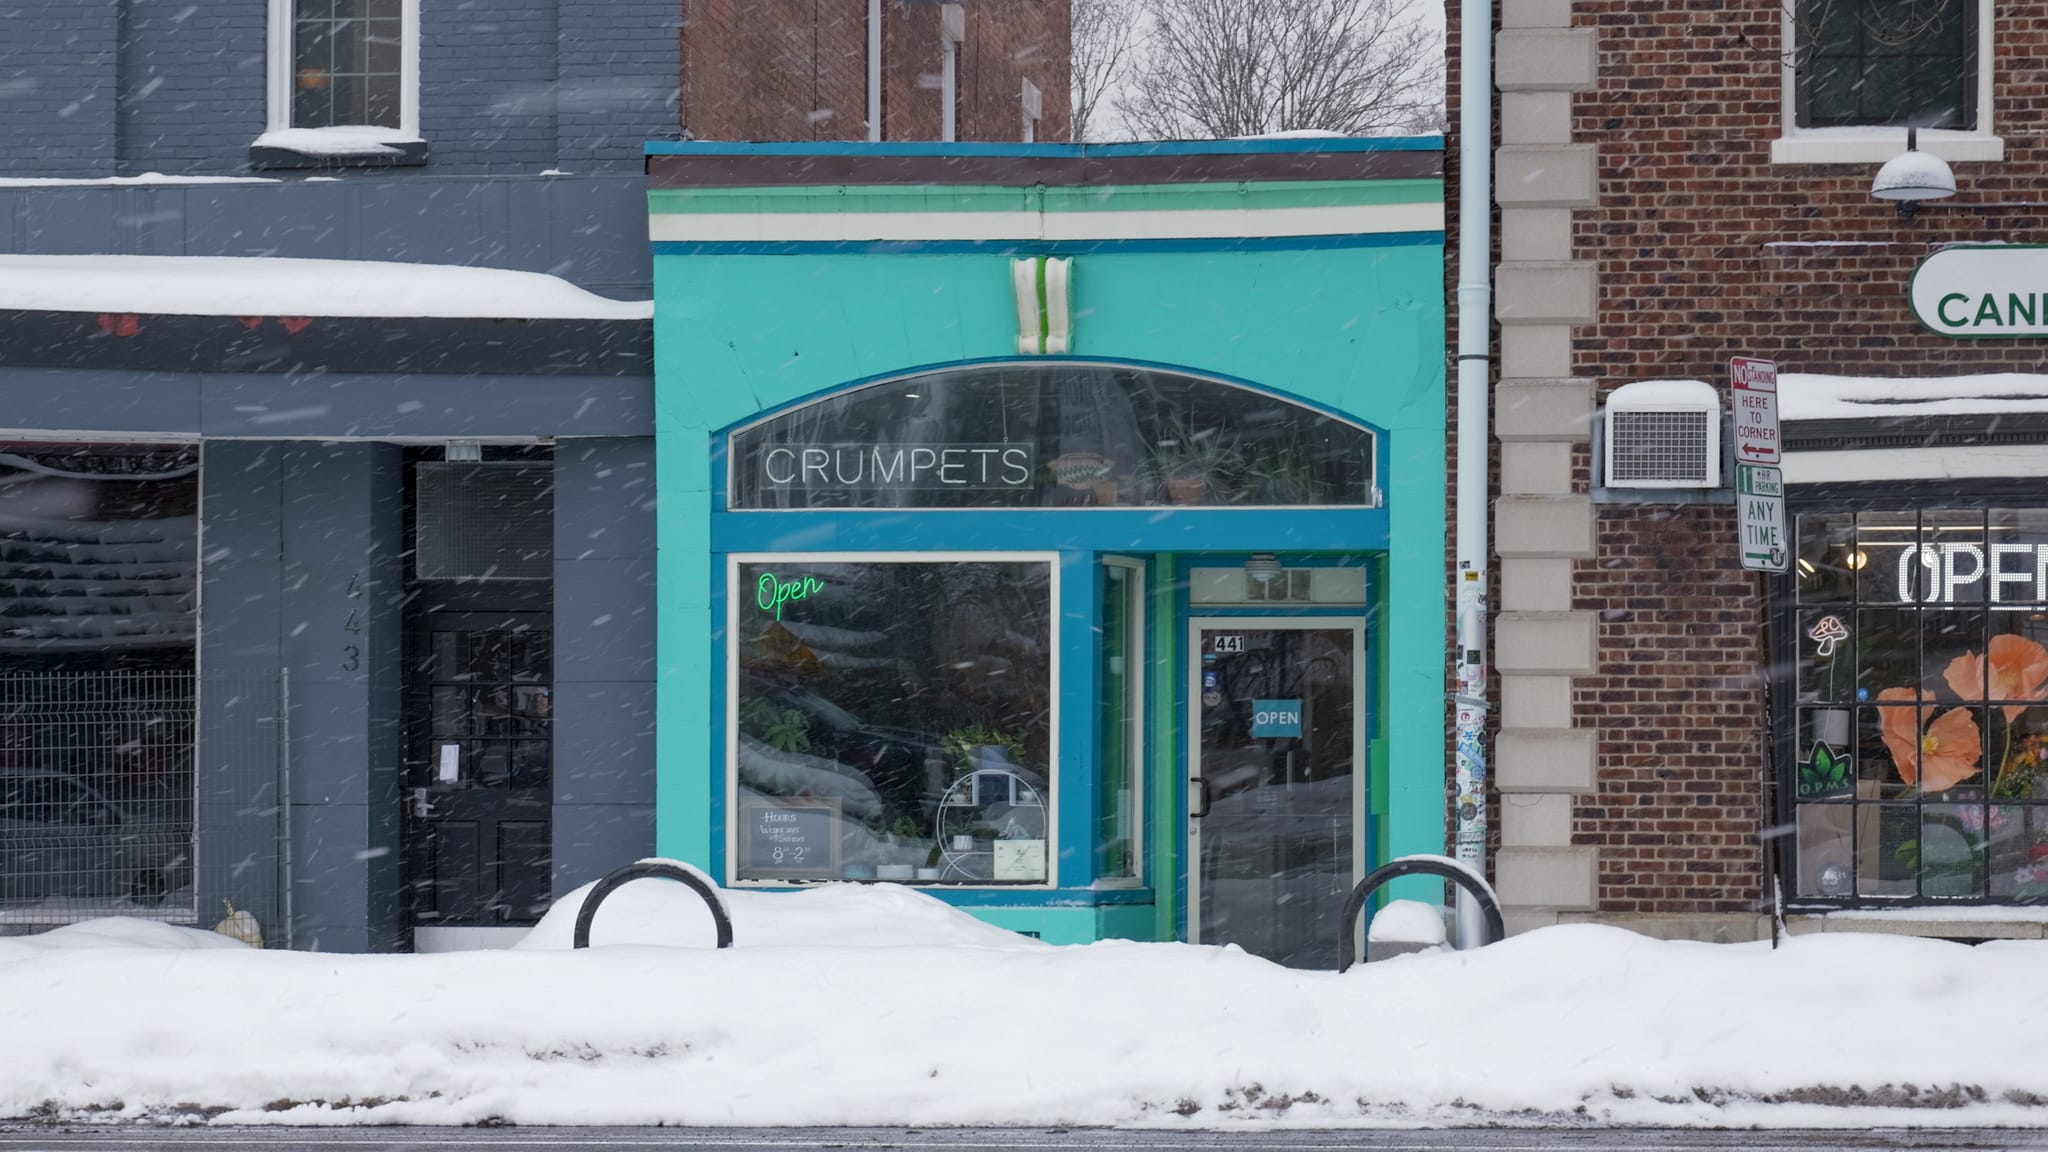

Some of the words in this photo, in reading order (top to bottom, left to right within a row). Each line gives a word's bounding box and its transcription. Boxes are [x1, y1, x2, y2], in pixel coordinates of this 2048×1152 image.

[1938, 292, 2048, 328] CAN
[1734, 364, 1748, 385] NO
[1748, 367, 1775, 385] STANDING
[1742, 396, 1769, 409] HERE
[1750, 411, 1762, 424] TO
[1738, 425, 1776, 440] CORNER
[766, 448, 1029, 484] CRUMPETS
[1742, 466, 1748, 493] 1
[1761, 469, 1771, 480] HR
[1755, 481, 1779, 494] PARKING
[1748, 500, 1775, 521] ANY
[1746, 525, 1779, 546] TIME
[1898, 543, 2048, 611] OPE
[758, 573, 824, 622] Open
[1216, 636, 1243, 651] 441
[1255, 711, 1299, 725] OPEN
